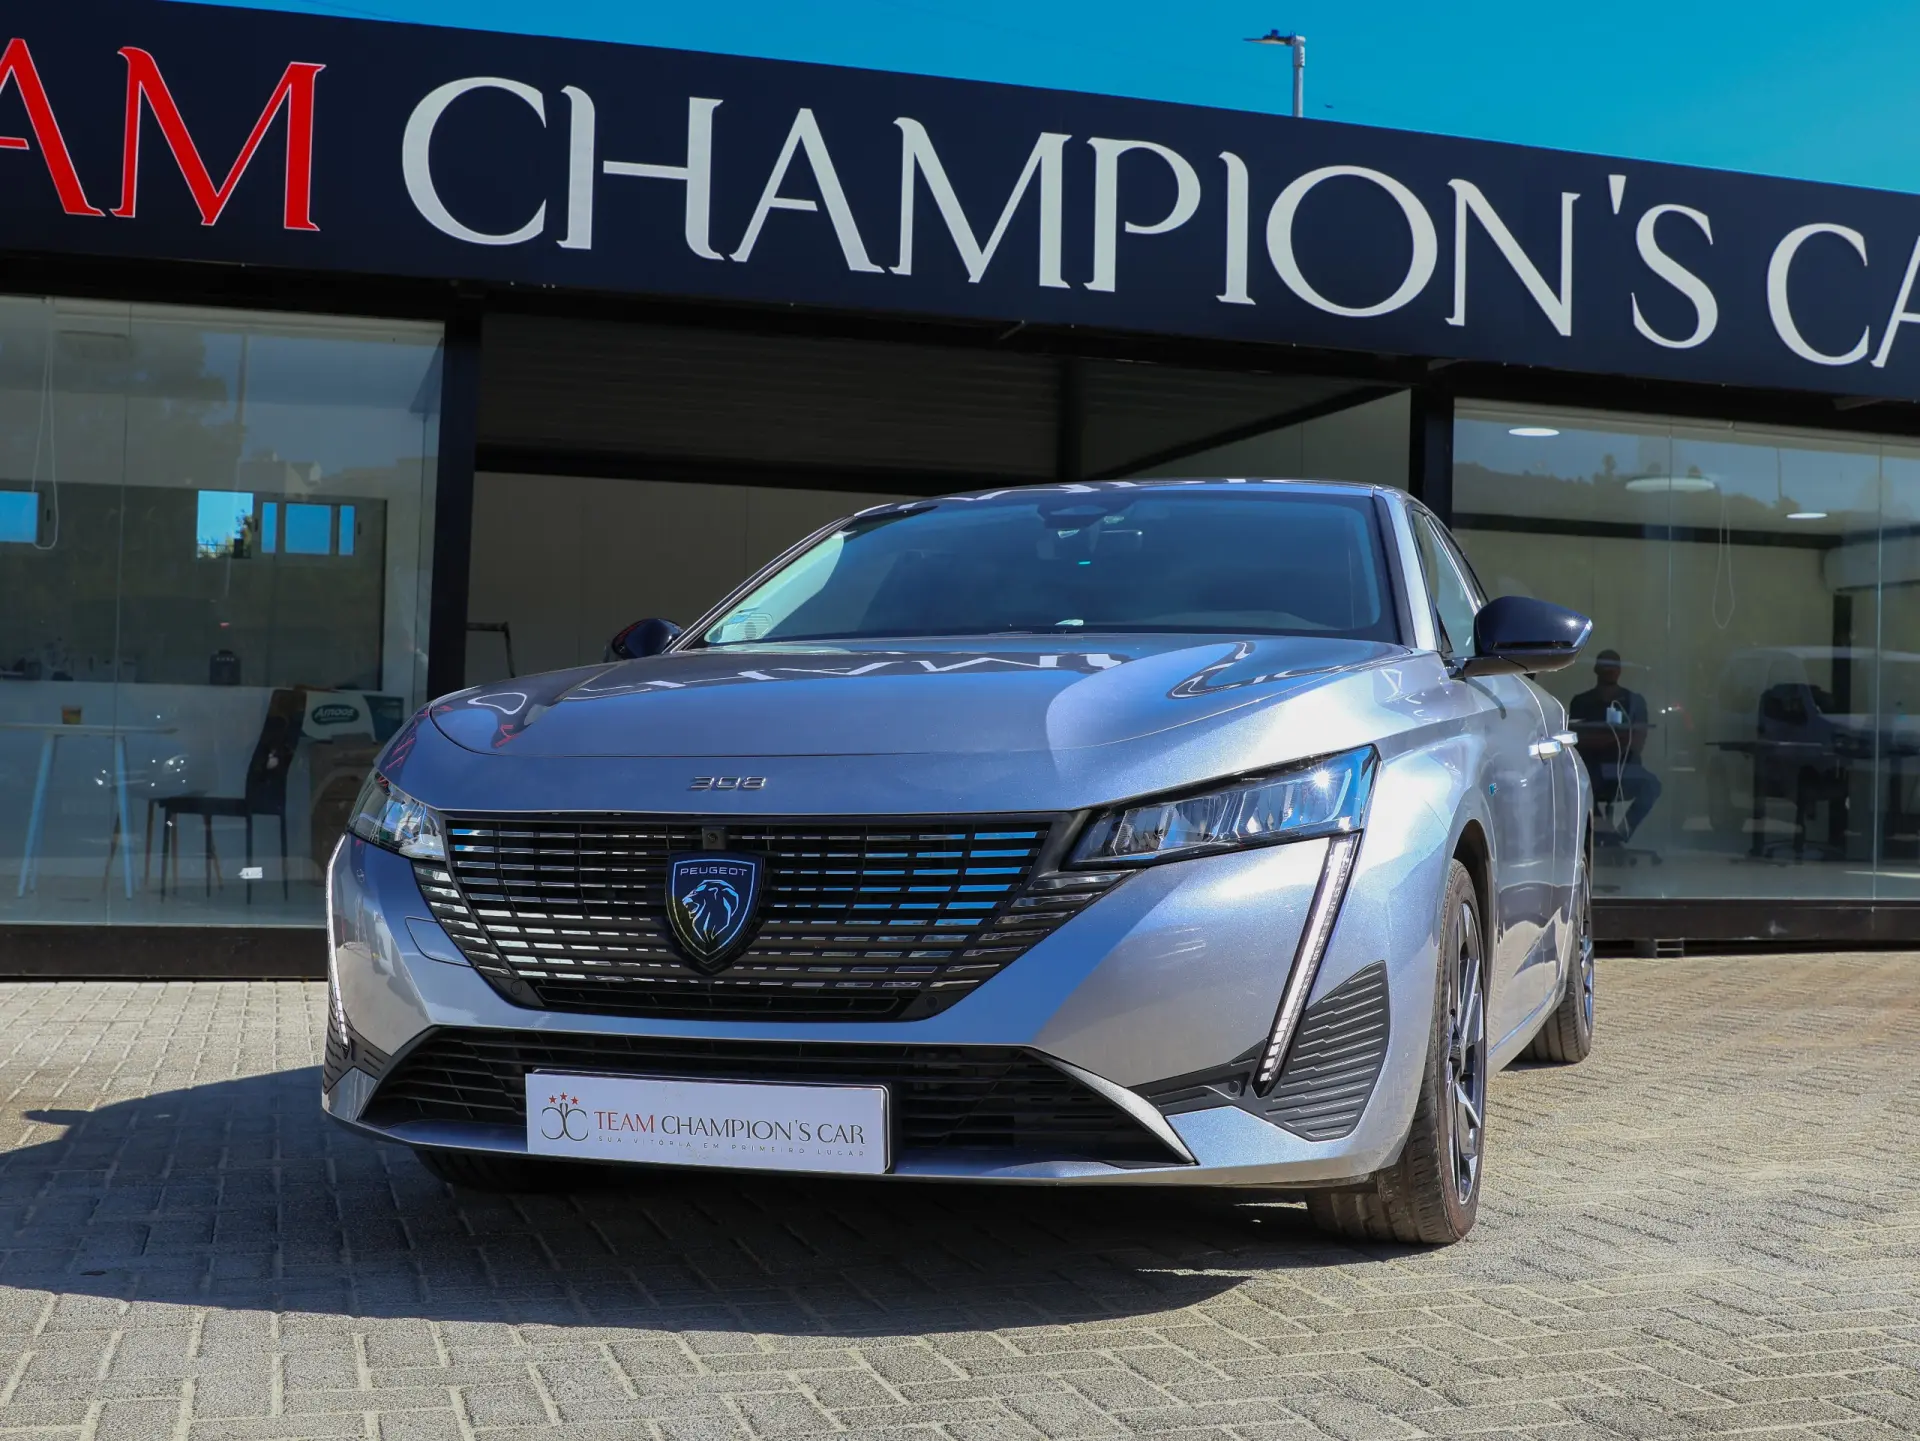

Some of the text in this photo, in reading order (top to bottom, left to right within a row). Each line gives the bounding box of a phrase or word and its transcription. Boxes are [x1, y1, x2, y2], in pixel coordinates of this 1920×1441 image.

[402, 76, 1719, 349] CHAMPION'S
[690, 776, 767, 790] 308
[679, 866, 748, 877] PEUGEOT
[593, 1111, 866, 1145] TEAM CHAMPION'S CAR
[598, 1135, 622, 1143] SUA
